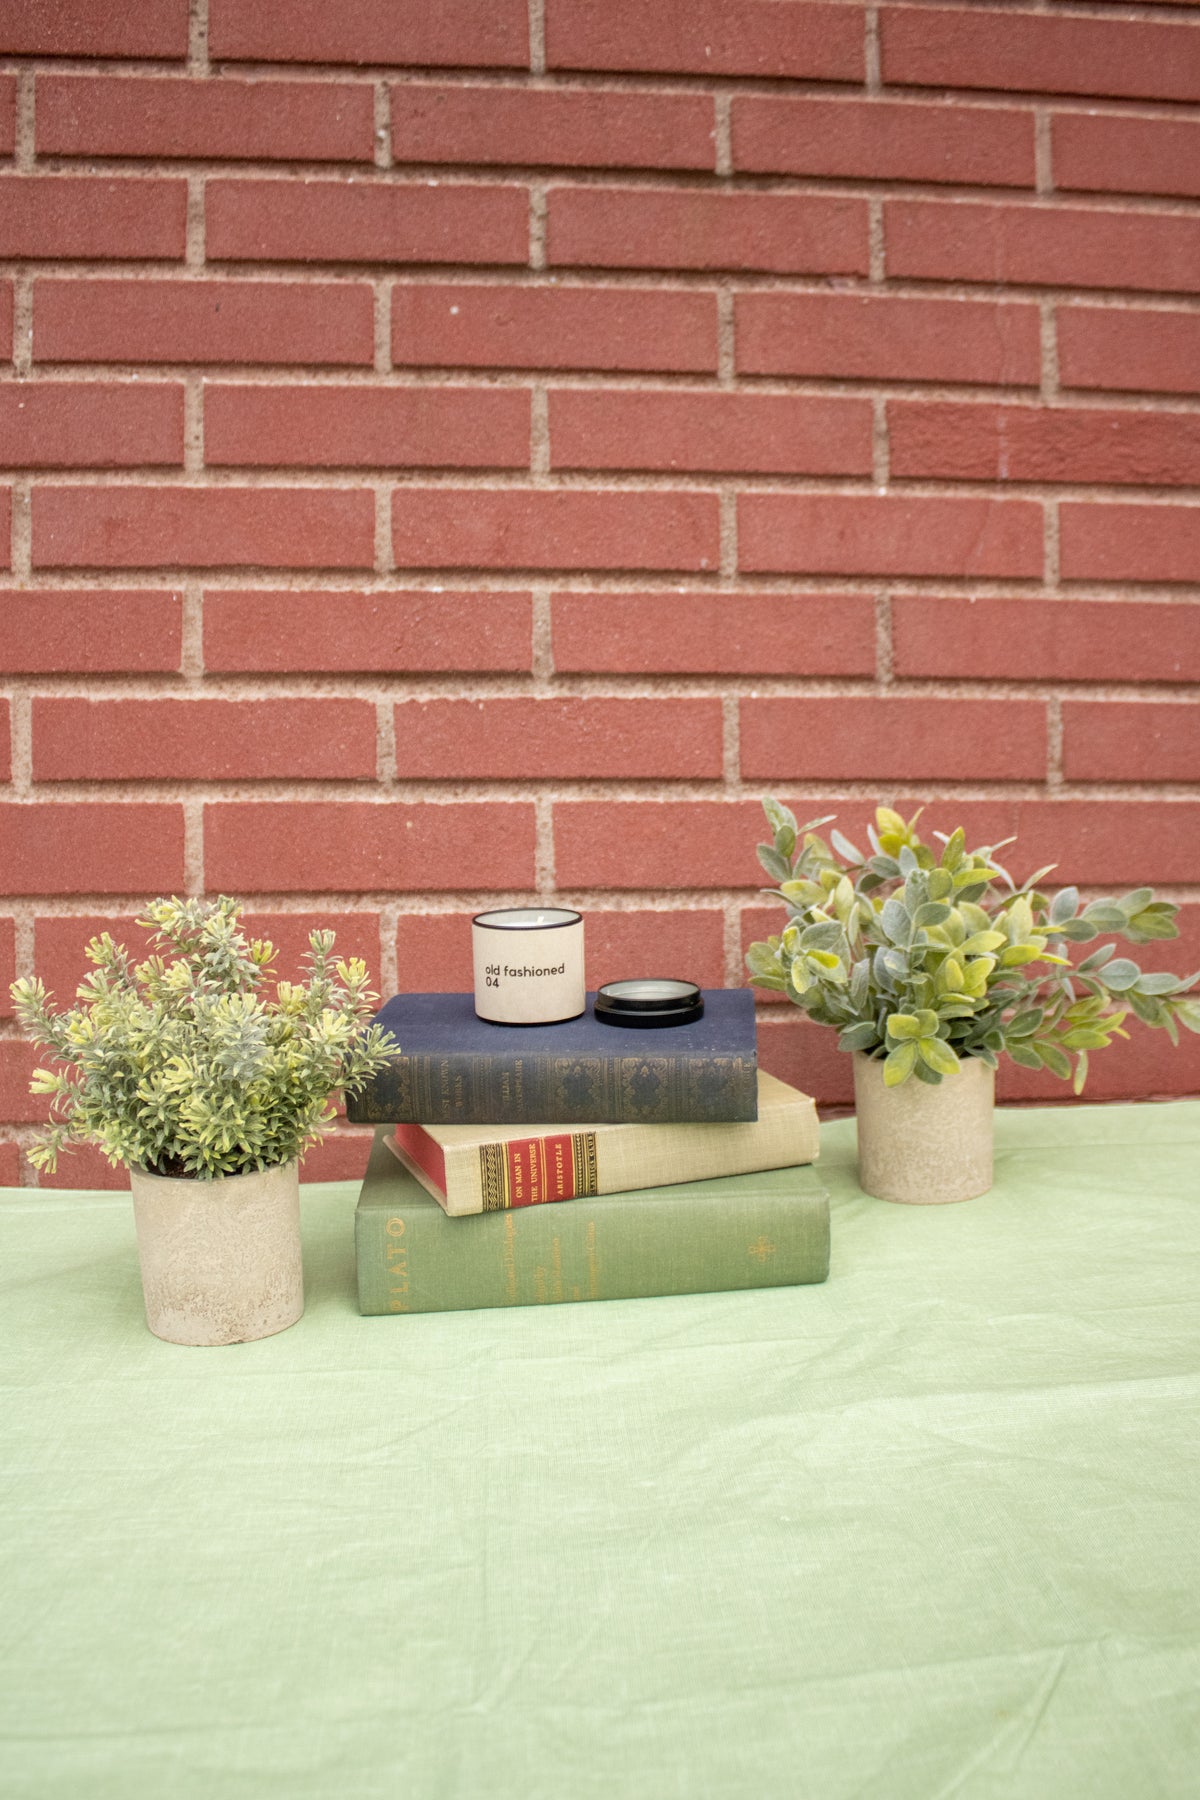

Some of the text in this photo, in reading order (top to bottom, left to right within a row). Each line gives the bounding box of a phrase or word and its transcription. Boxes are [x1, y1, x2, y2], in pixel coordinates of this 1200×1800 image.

[485, 963, 565, 977] old fashioned
[485, 976, 500, 988] 04
[513, 1153, 523, 1199] ON MAN IN
[528, 1143, 538, 1203] THE UNIVERSE
[555, 1143, 564, 1196] ARISTOTLE
[386, 1217, 409, 1312] PLATO
